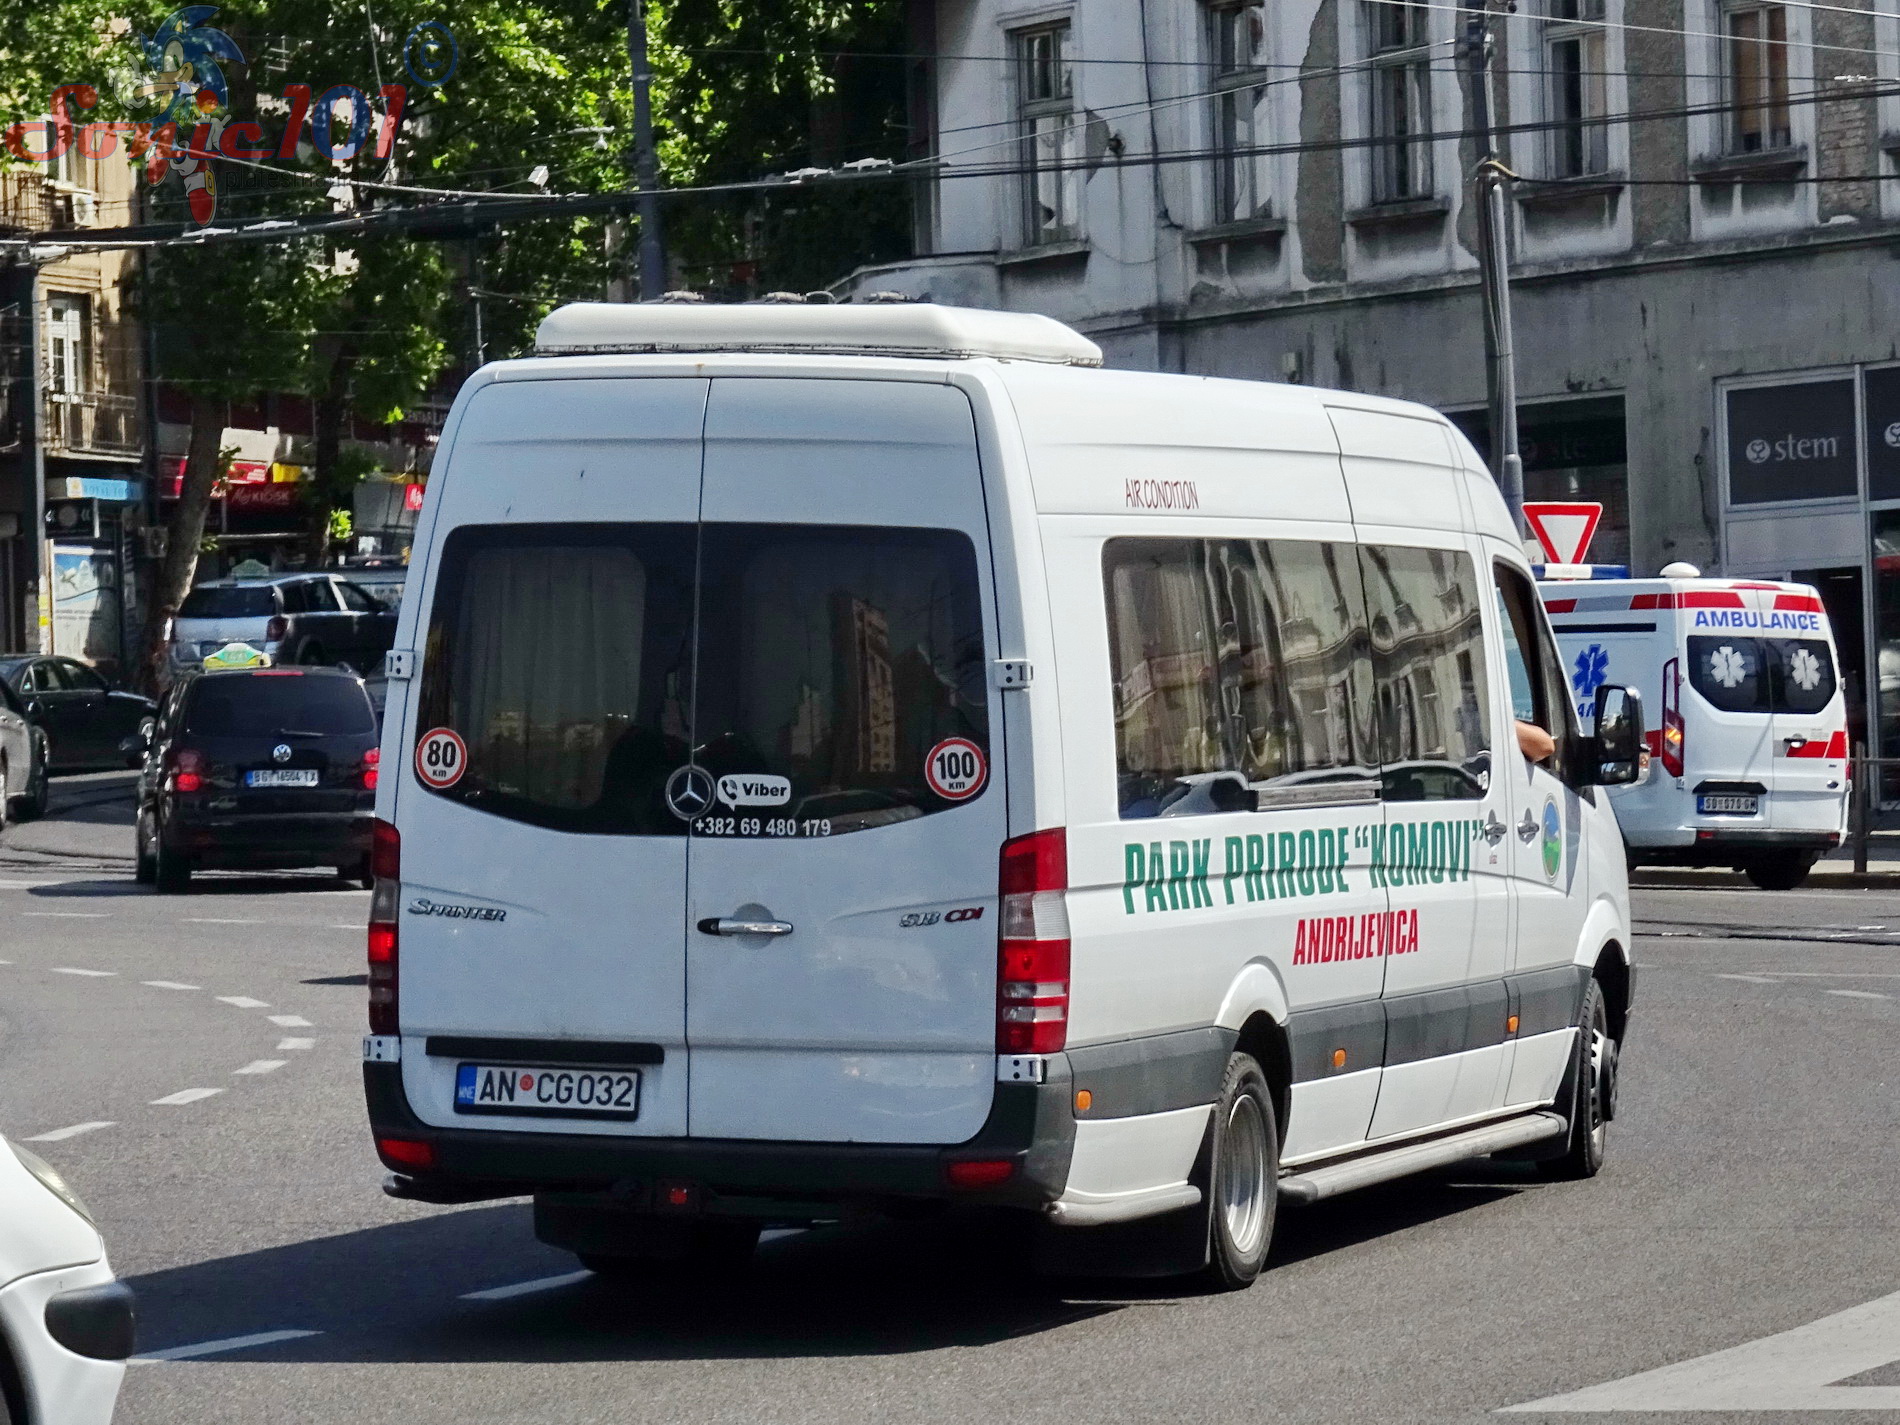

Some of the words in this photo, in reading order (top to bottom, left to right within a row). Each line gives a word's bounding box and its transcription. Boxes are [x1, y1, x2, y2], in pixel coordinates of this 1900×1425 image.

[1774, 433, 1838, 462] stem
[1125, 478, 1144, 508] AIR
[1144, 479, 1199, 510] CONDITION
[1695, 611, 1820, 631] AMBULANCE
[427, 740, 456, 768] 80
[936, 751, 974, 779] 100
[742, 783, 787, 796] Viber
[695, 816, 735, 835] +382
[740, 818, 760, 835] 69
[765, 818, 796, 836] 480
[802, 818, 831, 836] 179
[1123, 838, 1213, 915] PARK
[1223, 827, 1349, 905] PRIRODE
[944, 906, 984, 923] CDI
[1292, 908, 1419, 966] ANDRIJEVICA
[479, 1069, 516, 1102] AN
[536, 1073, 633, 1108] CG032
